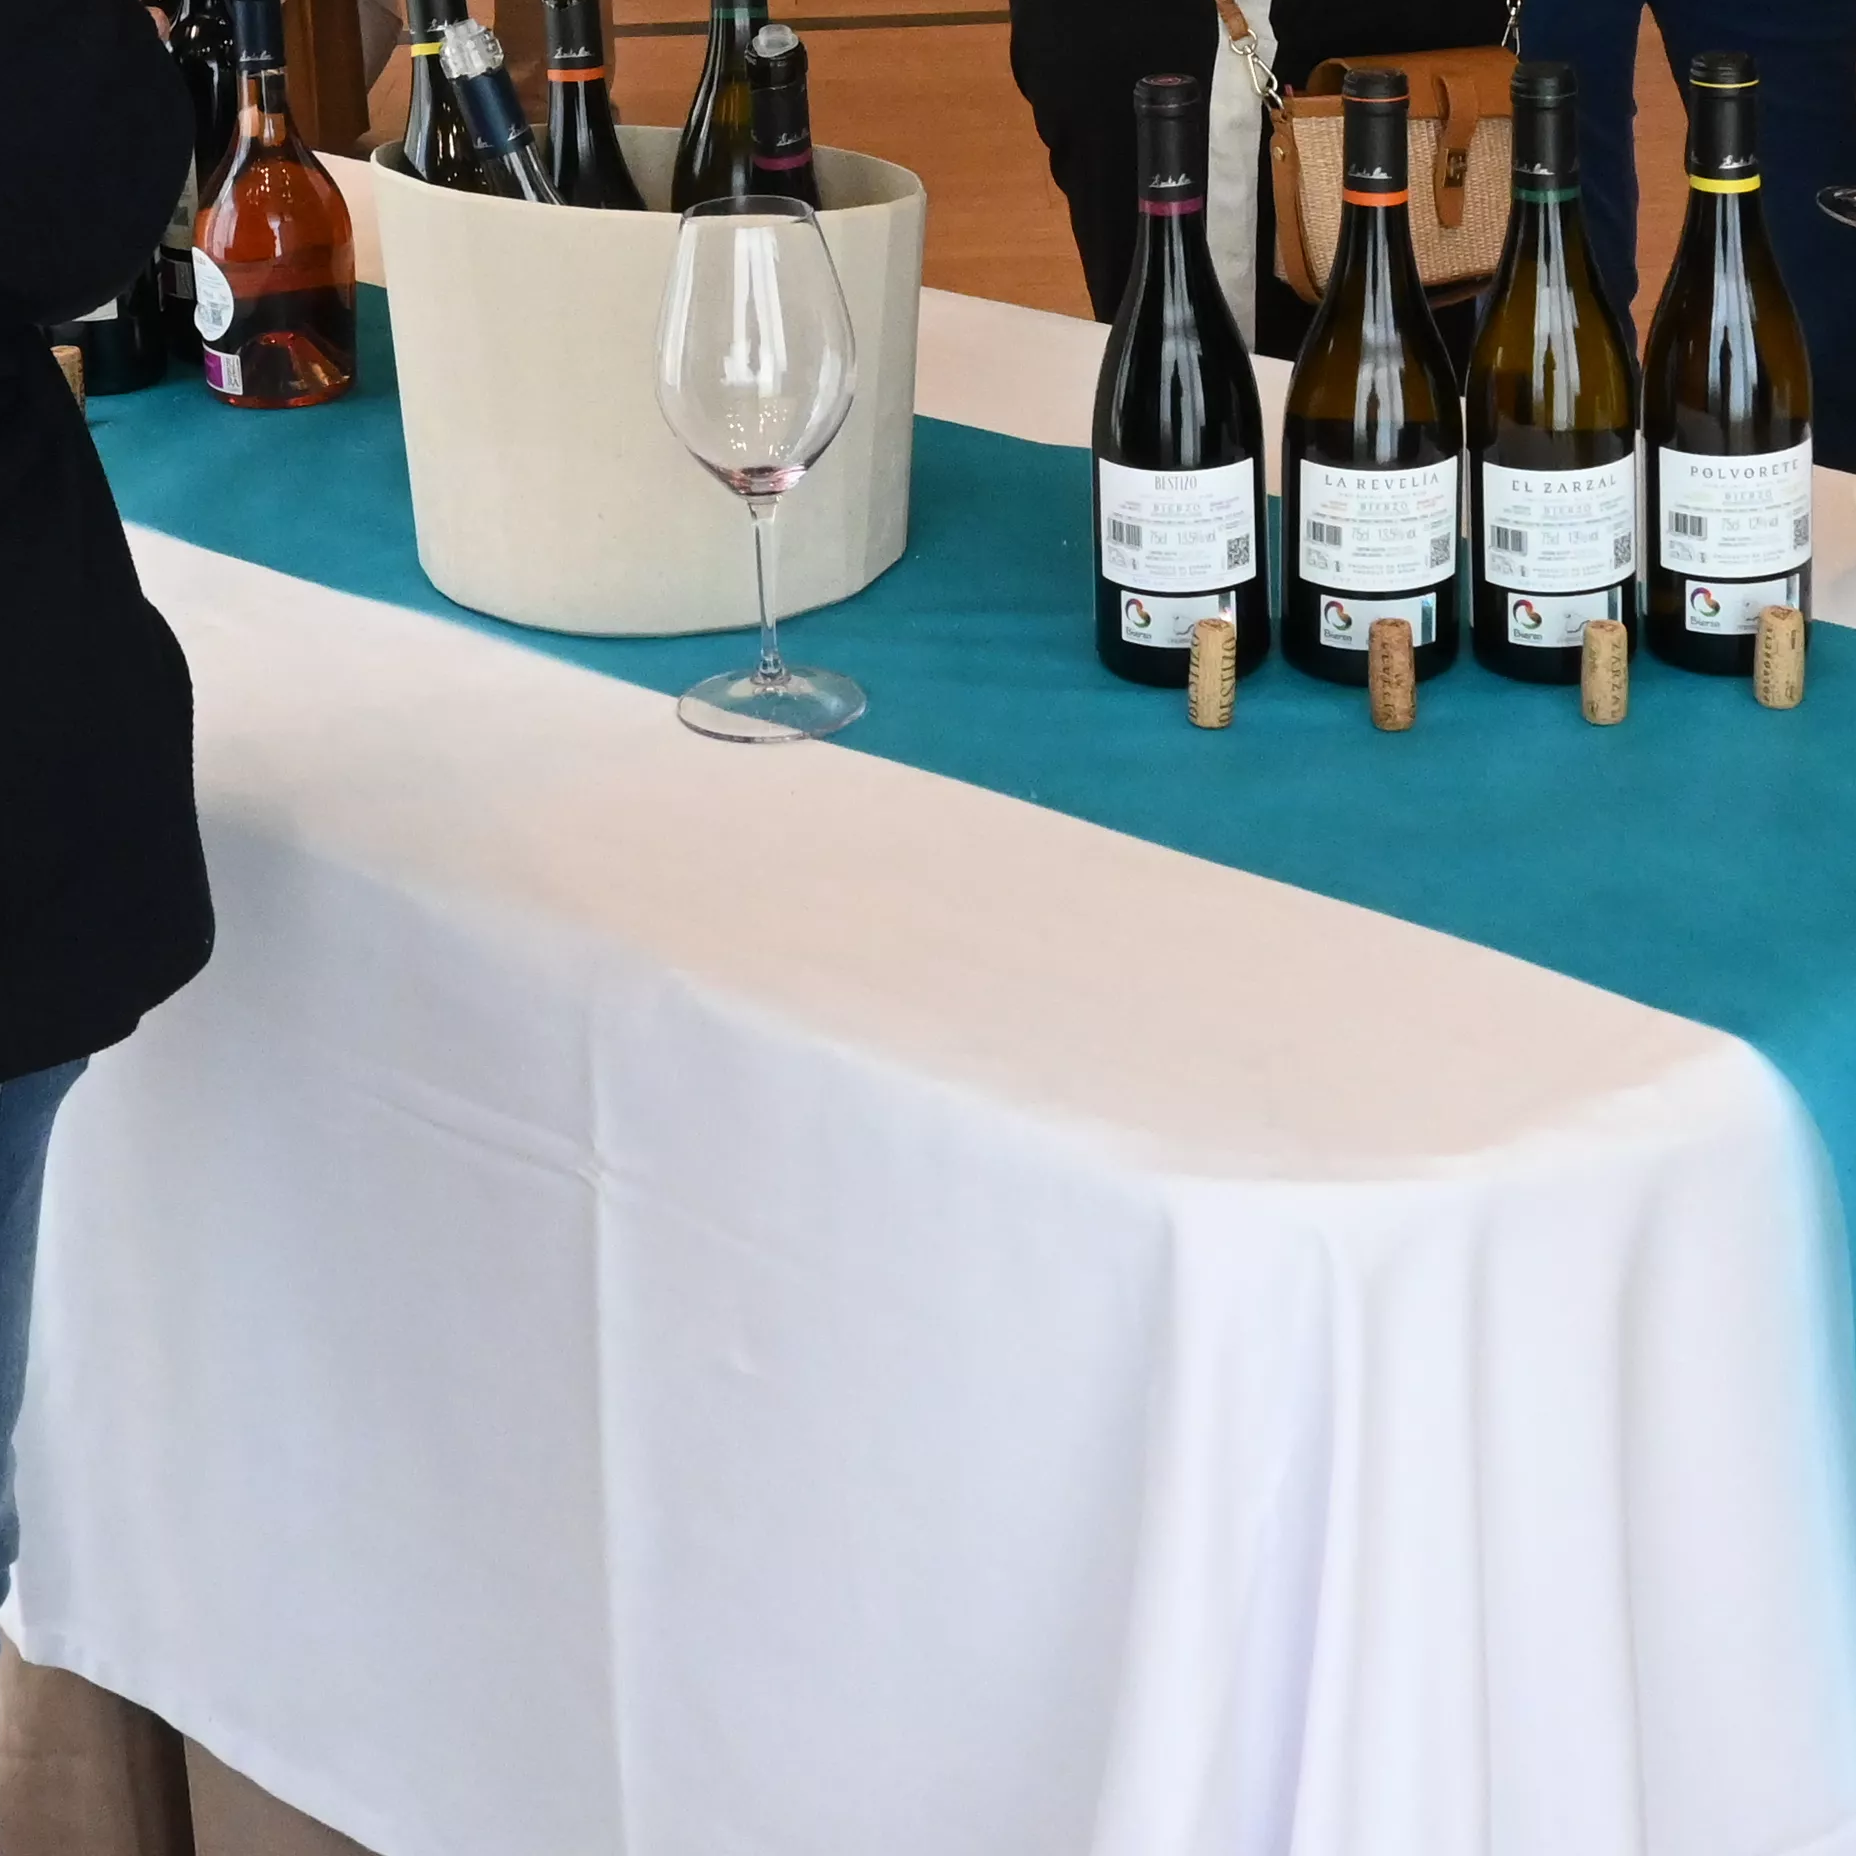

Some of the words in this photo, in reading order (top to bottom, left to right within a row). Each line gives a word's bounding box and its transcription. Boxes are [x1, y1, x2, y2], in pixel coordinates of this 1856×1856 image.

[1690, 459, 1799, 480] POLVORETE
[1154, 475, 1198, 491] BESTIZO
[1325, 474, 1347, 488] LA
[1512, 479, 1533, 493] EL
[1543, 474, 1617, 494] ZARZAL
